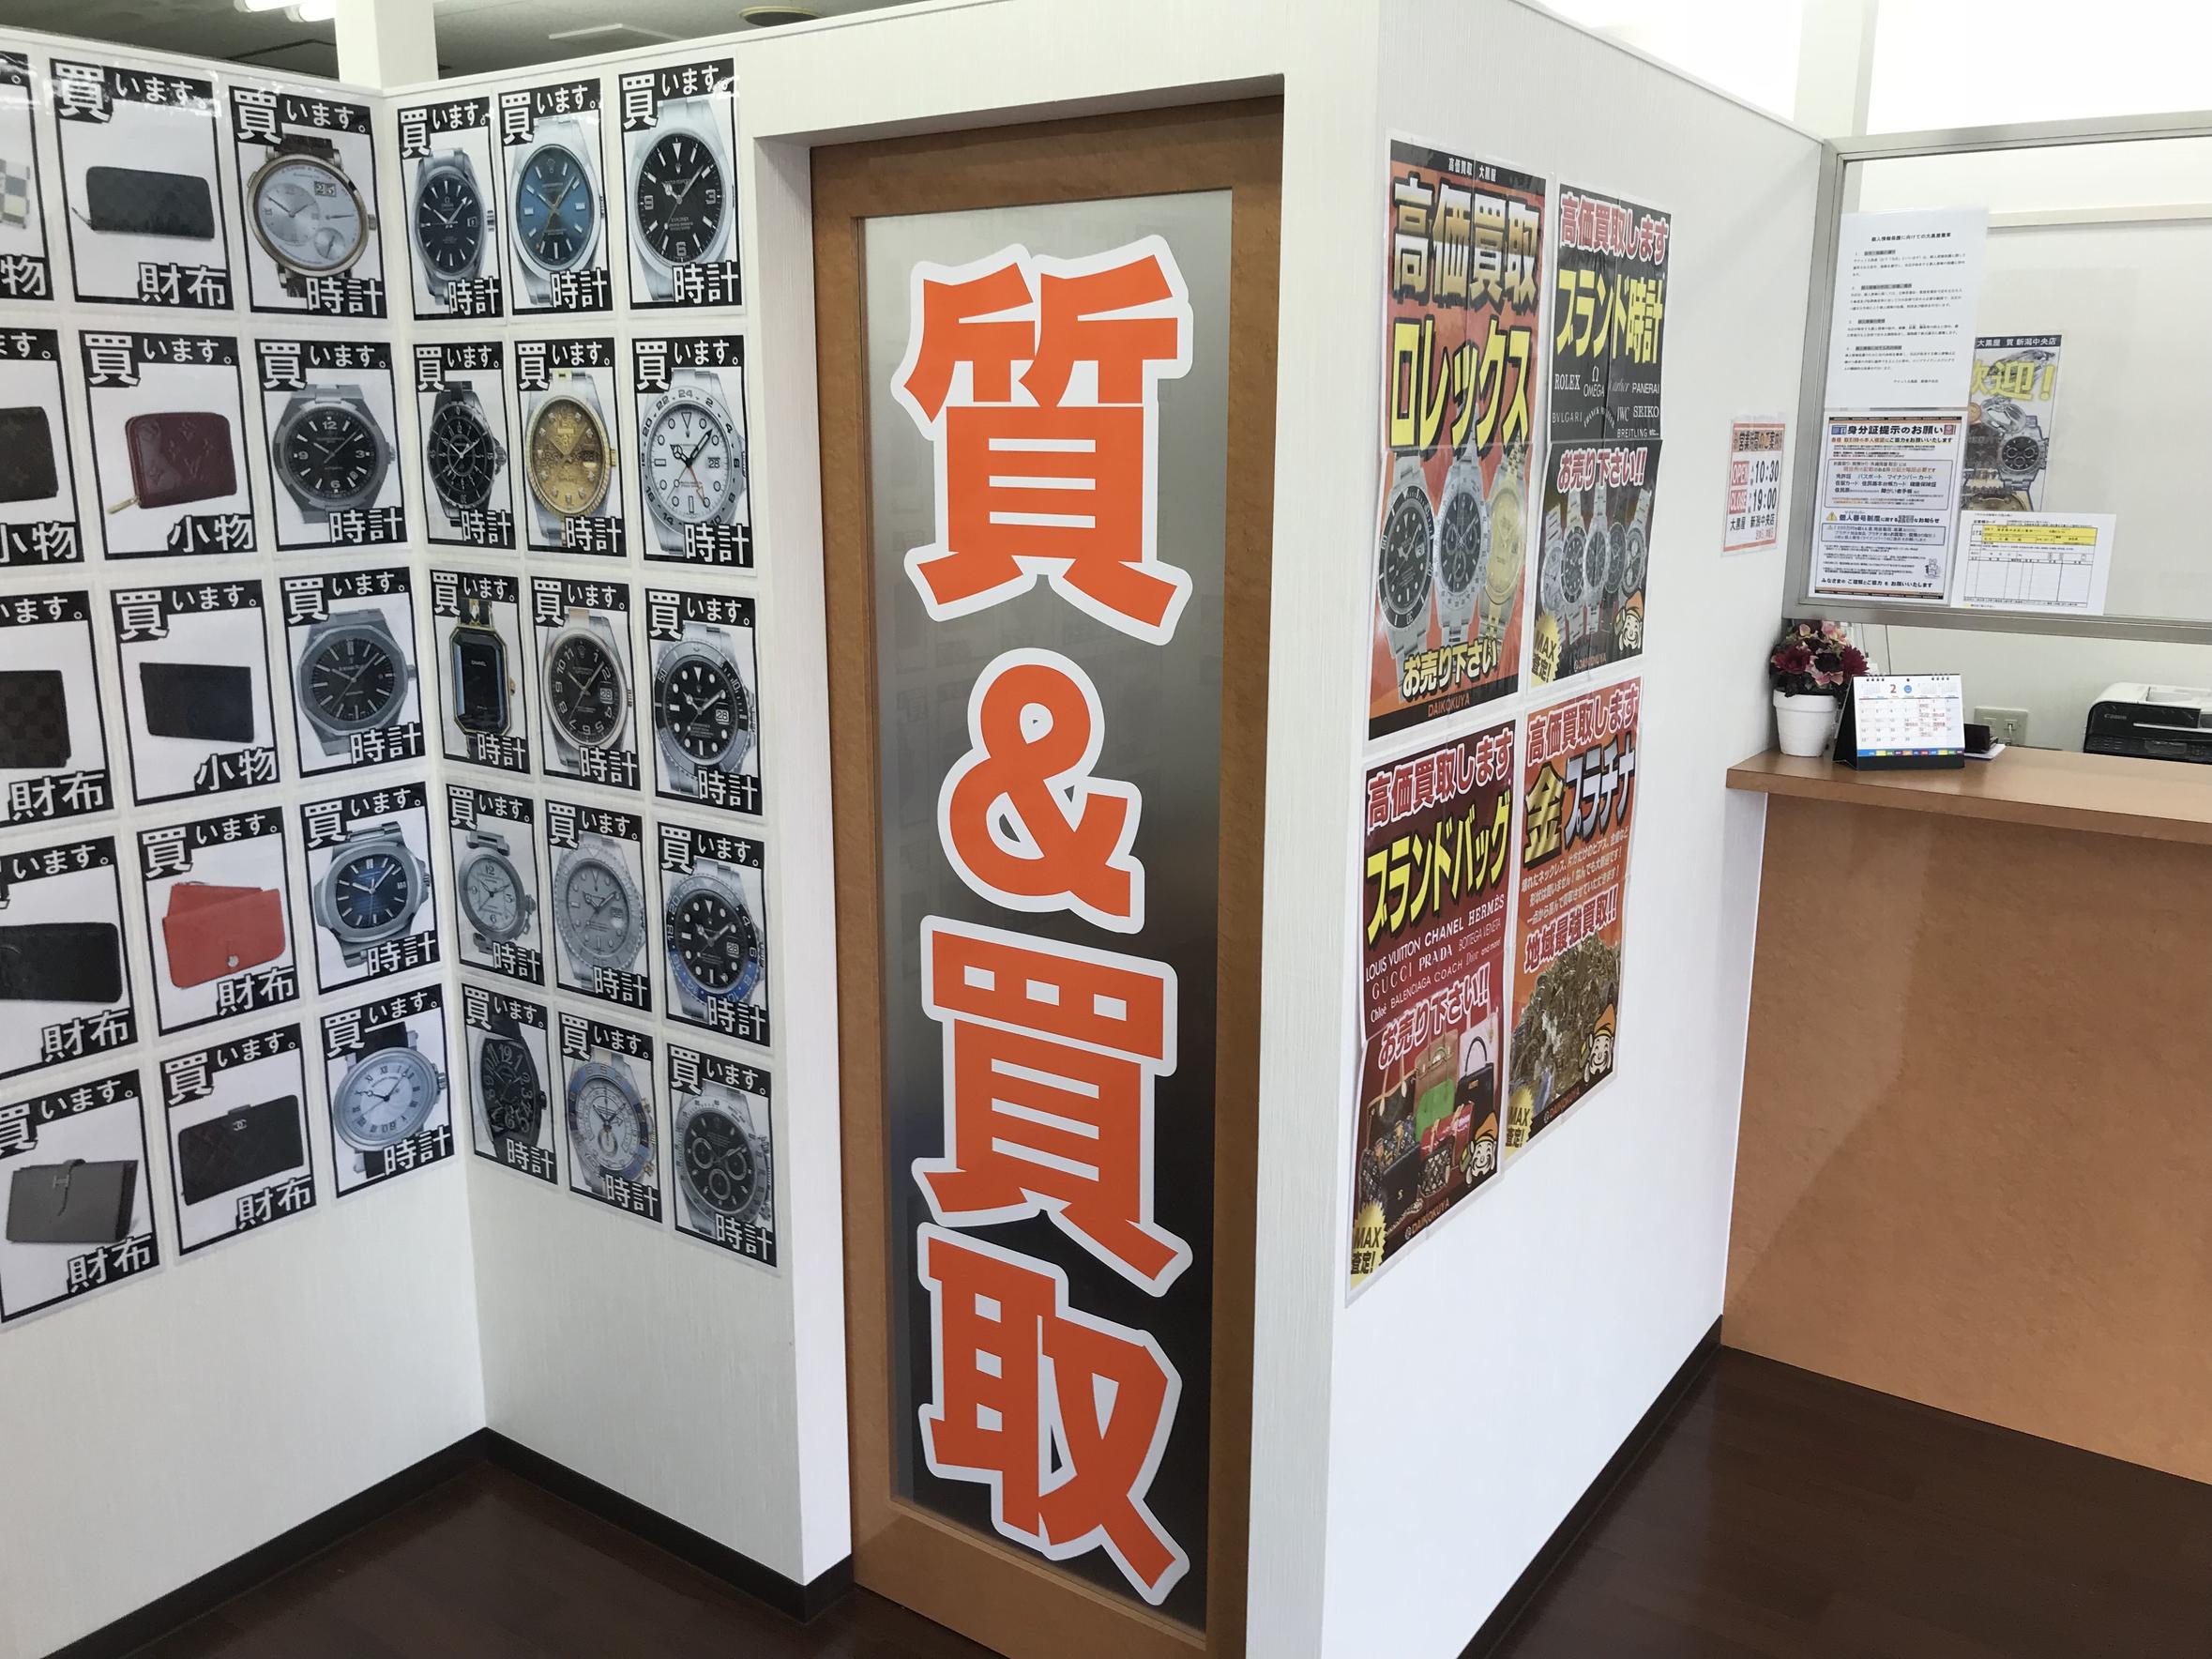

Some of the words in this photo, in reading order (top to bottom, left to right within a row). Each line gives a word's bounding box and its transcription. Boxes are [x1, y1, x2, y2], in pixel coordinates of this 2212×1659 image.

[55, 62, 206, 122] 買います。
[501, 84, 597, 144] 買います。
[622, 65, 728, 129] 買います。
[234, 90, 366, 144] 買います。
[400, 102, 487, 158] 買います。
[1448, 158, 1473, 176] 高価買取
[1394, 174, 1540, 309] 高価買取
[1560, 191, 1669, 266] 高価買取します
[0, 255, 46, 296] 物
[141, 264, 226, 306] 財布
[307, 279, 383, 315] 時計
[448, 279, 499, 315] 時計
[551, 268, 607, 308] 時計
[672, 263, 739, 304] 時計
[1556, 269, 1663, 364] ブランド時計
[85, 333, 232, 386] 買います。
[2017, 338, 2057, 346] 新潟中央店
[260, 342, 386, 389] 買います。
[417, 345, 499, 391] 買います。
[517, 342, 610, 390] 買います。
[635, 340, 738, 391] 買います。
[1390, 317, 1532, 454] ロレックス
[1554, 374, 1581, 390] ROLEX
[1583, 384, 1605, 397] OMEGA
[1631, 382, 1660, 394] PANERAI
[323, 420, 337, 430] 12
[1553, 411, 1583, 423] BVLGARI
[1633, 405, 1659, 419] SEIKO
[1617, 429, 1647, 437] BREITLING
[1848, 425, 1944, 435] 身分証提示のお願い
[298, 450, 307, 460] 9
[356, 449, 365, 459] 3
[1755, 460, 1779, 483] 10:30
[331, 479, 340, 490] 6
[1753, 487, 1777, 512] 19:00
[0, 523, 77, 562] 小物
[169, 516, 253, 553] 小物
[330, 510, 403, 543] 時計
[460, 510, 512, 546] 時計
[565, 517, 622, 553] 時計
[685, 522, 750, 565] 時計
[116, 585, 257, 638] 買います。
[285, 571, 404, 623] 買います。
[432, 572, 515, 616] 買います。
[534, 579, 625, 625] 買います。
[648, 591, 750, 639] 買います。
[1401, 640, 1498, 700] お売り下さい
[1534, 633, 1556, 662] MAX
[1428, 693, 1472, 718] DAIKOKUYA
[1890, 684, 1897, 693] 2
[350, 723, 421, 764] 時計
[1527, 683, 1639, 768] 高価買取します
[195, 748, 277, 791] 小物
[477, 731, 526, 770] 時計
[581, 747, 638, 786] 時計
[10, 772, 105, 821] 財布
[698, 768, 758, 811] 時計
[1367, 727, 1513, 835] 高価買取します
[1565, 735, 1635, 849] プラチナ
[305, 788, 422, 848] 買います。
[449, 786, 530, 830] 買います。
[548, 801, 638, 848] 買います。
[1524, 765, 1564, 869] 金
[142, 814, 278, 878] 買います。
[660, 826, 759, 875] 買います。
[1367, 789, 1510, 945] ブランドバッグ
[0, 845, 109, 908] います。
[367, 934, 436, 976] 時計
[492, 942, 540, 982] 時計
[1366, 956, 1386, 982] LOUIS
[1388, 939, 1420, 965] VUITTON
[1425, 918, 1463, 946] CHANEL
[1372, 963, 1412, 999] GUCCI
[1418, 945, 1452, 971] PRADA
[218, 966, 295, 1016] 財布
[593, 966, 648, 1009] 時計
[1390, 976, 1431, 1009] BALENCIAGA
[1434, 961, 1462, 982] COACH
[325, 992, 438, 1058] 買います。
[464, 988, 544, 1031] 買います。
[707, 997, 765, 1041] 時計
[42, 1009, 129, 1061] 財布
[562, 1014, 649, 1060] 買います。
[165, 1030, 296, 1106] 買います。
[670, 1046, 766, 1097] 買います。
[0, 1080, 133, 1155] 買います。
[1508, 1106, 1530, 1127] MAX
[383, 1128, 451, 1176] 時計
[507, 1139, 553, 1180] 時計
[236, 1176, 312, 1230] 財布
[604, 1174, 658, 1217] 時計
[715, 1213, 772, 1260] 時計
[1354, 1226, 1382, 1250] MAX
[68, 1233, 152, 1293] 財布
